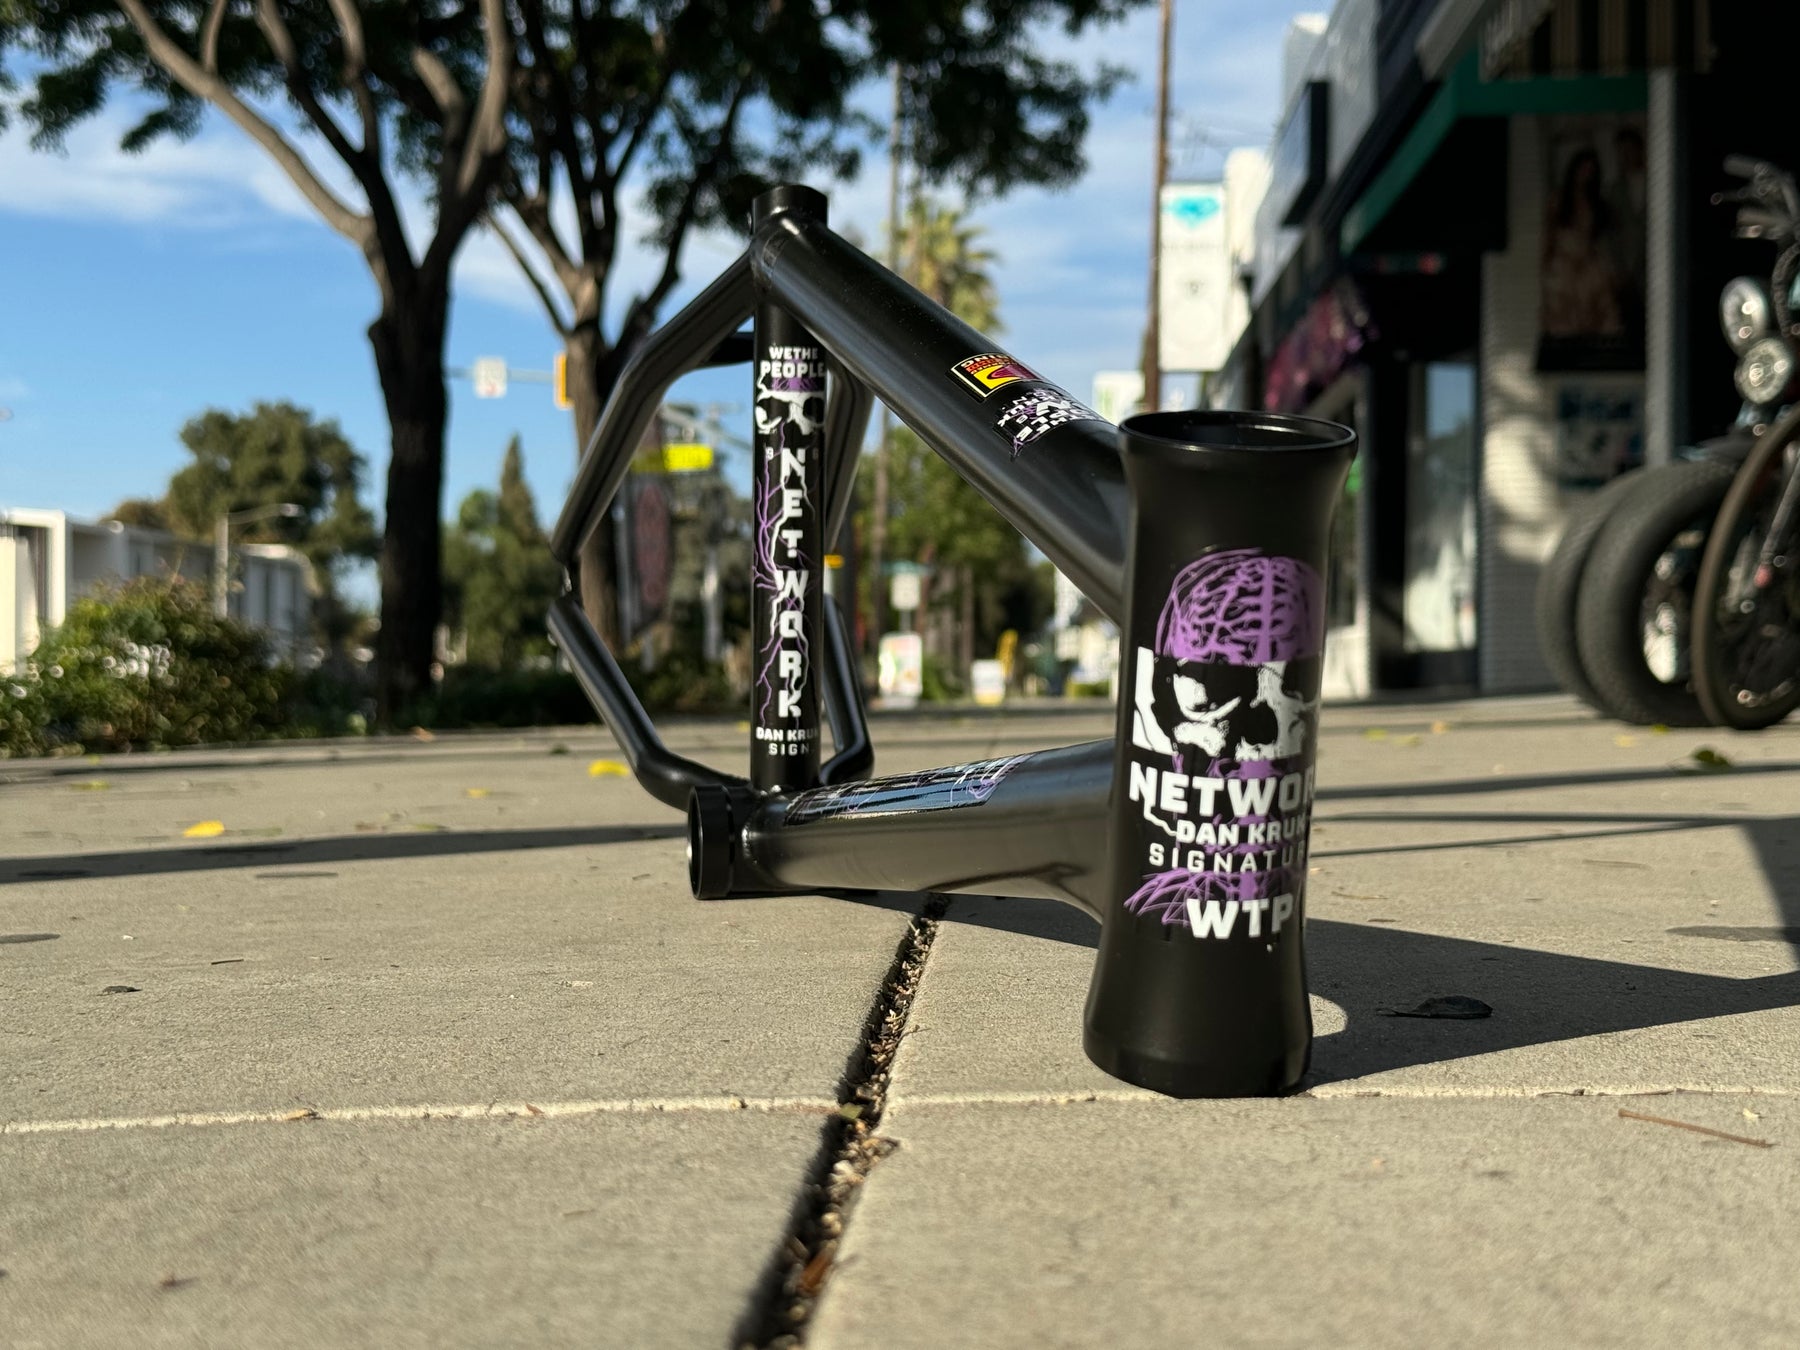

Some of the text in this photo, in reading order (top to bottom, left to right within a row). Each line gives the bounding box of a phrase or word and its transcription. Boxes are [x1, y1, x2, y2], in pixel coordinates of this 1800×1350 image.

[768, 345, 819, 360] WETHE
[760, 360, 825, 378] PEOPLE
[755, 726, 785, 742] DAN
[1175, 819, 1240, 846] DAN
[1186, 893, 1294, 939] WTP
